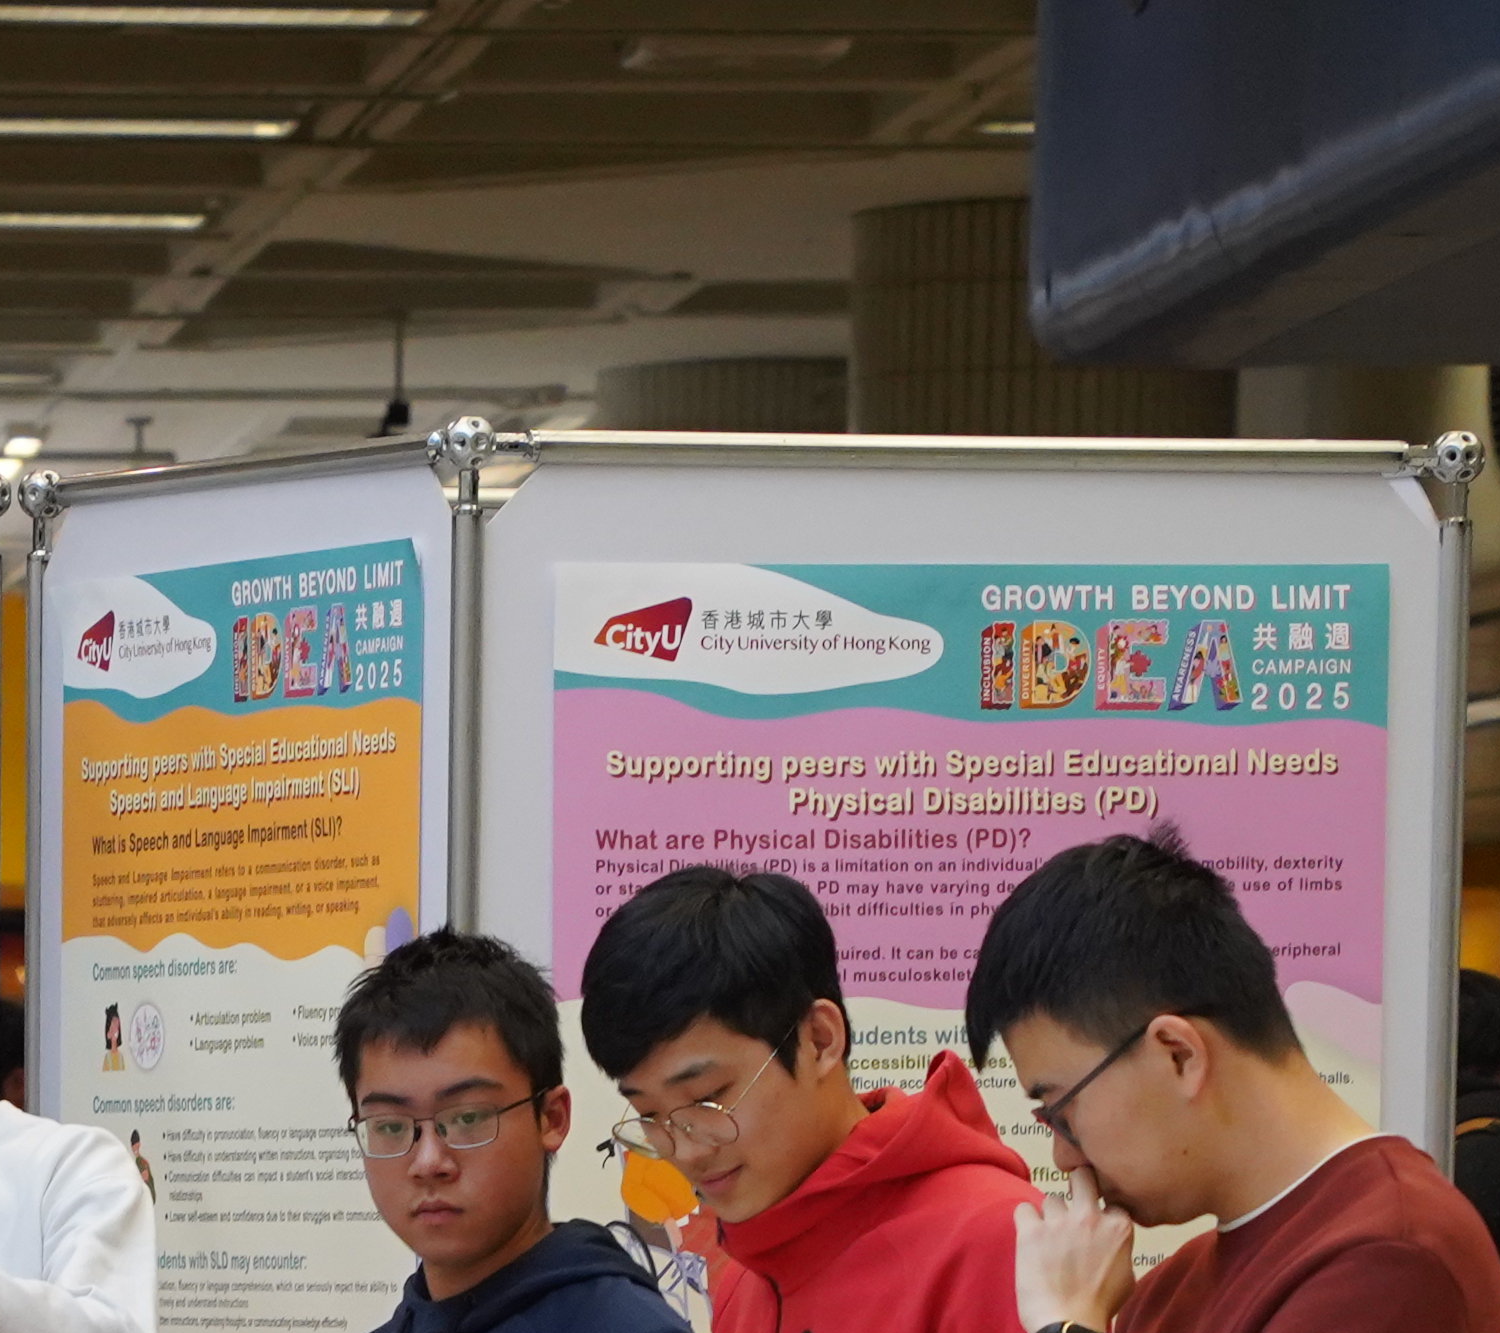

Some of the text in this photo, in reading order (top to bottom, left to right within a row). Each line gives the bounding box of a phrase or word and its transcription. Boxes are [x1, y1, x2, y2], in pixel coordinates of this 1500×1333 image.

[982, 584, 1350, 610] GROWTH BEYOND LIMIT
[701, 609, 834, 630] 香港城市大學
[605, 624, 683, 657] CityU
[700, 634, 932, 656] City University of Hong Kong
[1252, 623, 1351, 651] 共融週
[981, 617, 1244, 711] IDEA
[983, 636, 993, 701] INCLUSION
[1021, 638, 1031, 700] DIVERSITY
[1097, 647, 1107, 691] EQUITY
[1171, 629, 1197, 702] AWARENESS
[1251, 658, 1352, 676] CAMPAIGN
[1250, 682, 1351, 710] 2025
[82, 727, 395, 782] Supporting peers with Special Educational Needs
[606, 748, 1336, 780] Supporting peers with Special Educational Needs
[110, 767, 359, 818] Speech and Language Impairment (SLI)
[789, 785, 1155, 818] Physical Disabilities (PD)
[93, 959, 237, 981] Common speech disorders are:
